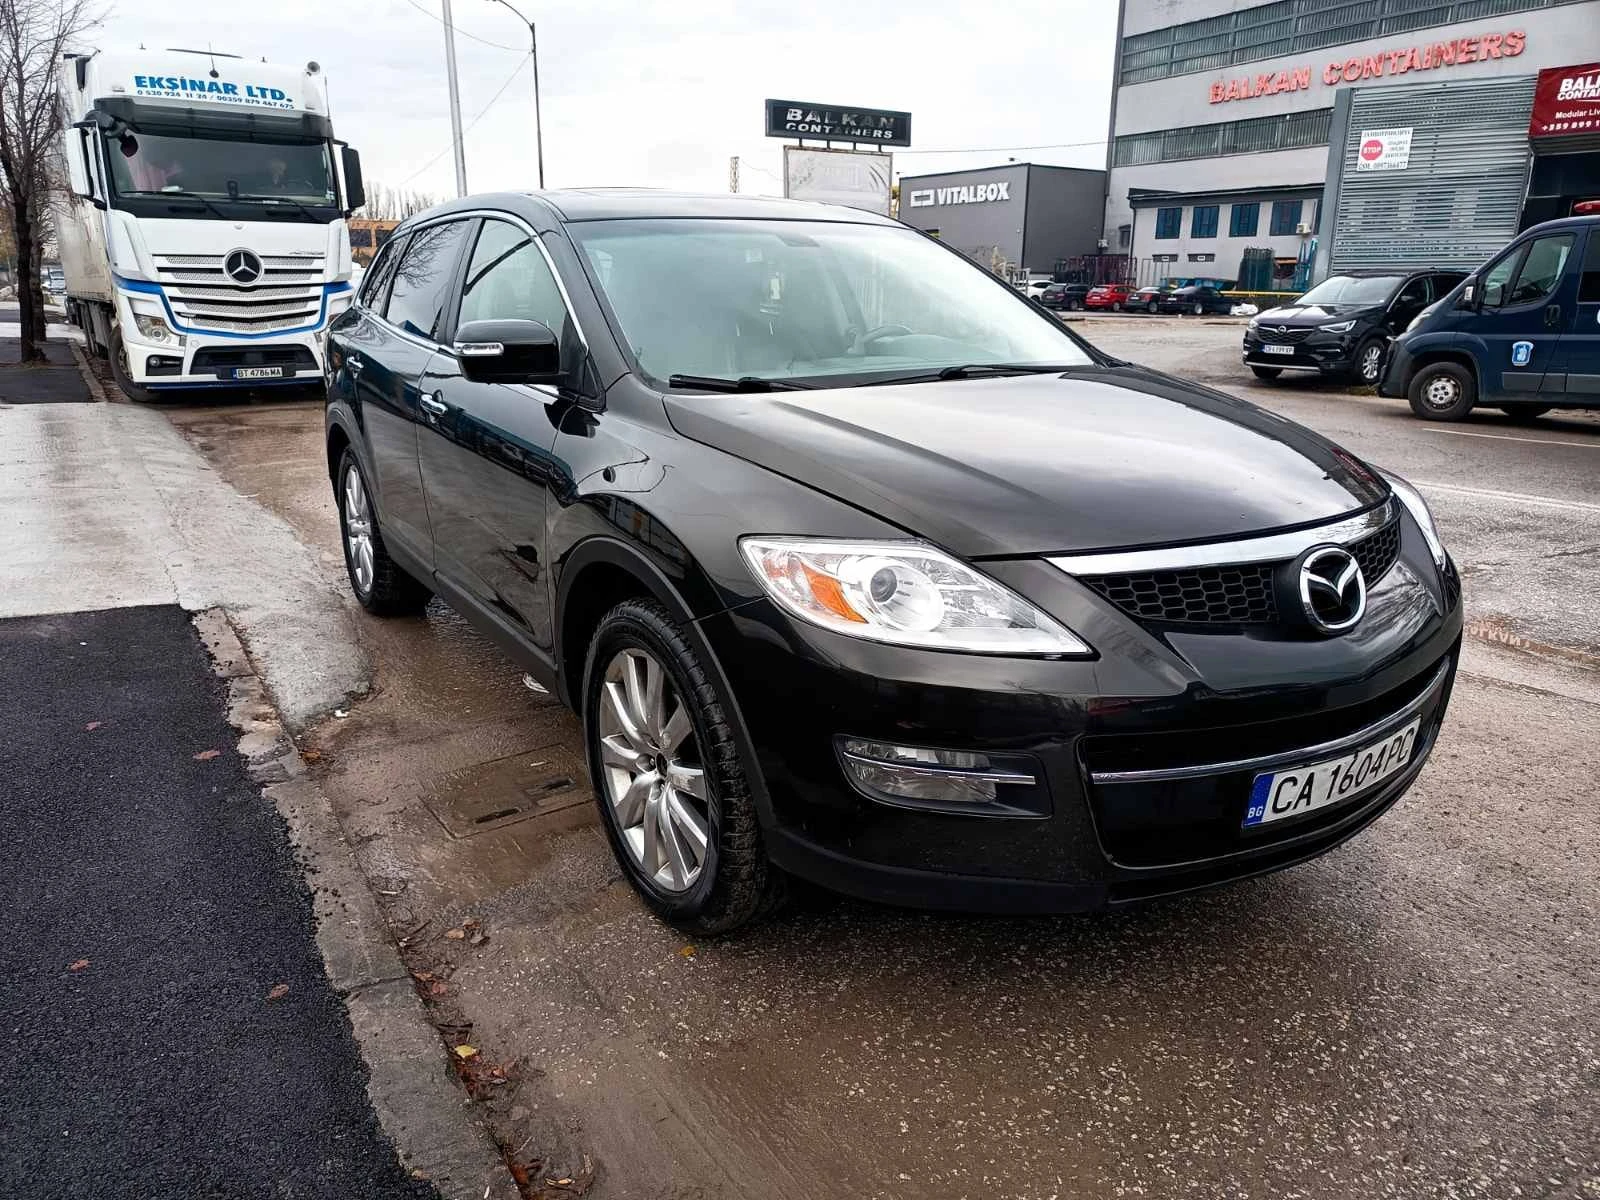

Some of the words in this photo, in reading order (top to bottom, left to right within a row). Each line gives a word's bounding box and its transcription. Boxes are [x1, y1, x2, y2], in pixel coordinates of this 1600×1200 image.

[1208, 65, 1312, 104] BALKAN
[1322, 30, 1526, 86] CONTAINERS
[134, 75, 239, 96] EKŞİNAR
[246, 85, 293, 103] LTD.
[786, 108, 895, 128] BALKAN
[1555, 110, 1587, 119] Modular
[785, 122, 894, 139] CONTAINERS
[1363, 146, 1382, 154] STOP
[937, 182, 1010, 205] VITALBOX
[1271, 771, 1316, 815] CA
[1326, 744, 1387, 800] 1604
[1382, 727, 1414, 773] PC
[1247, 806, 1263, 819] BG
